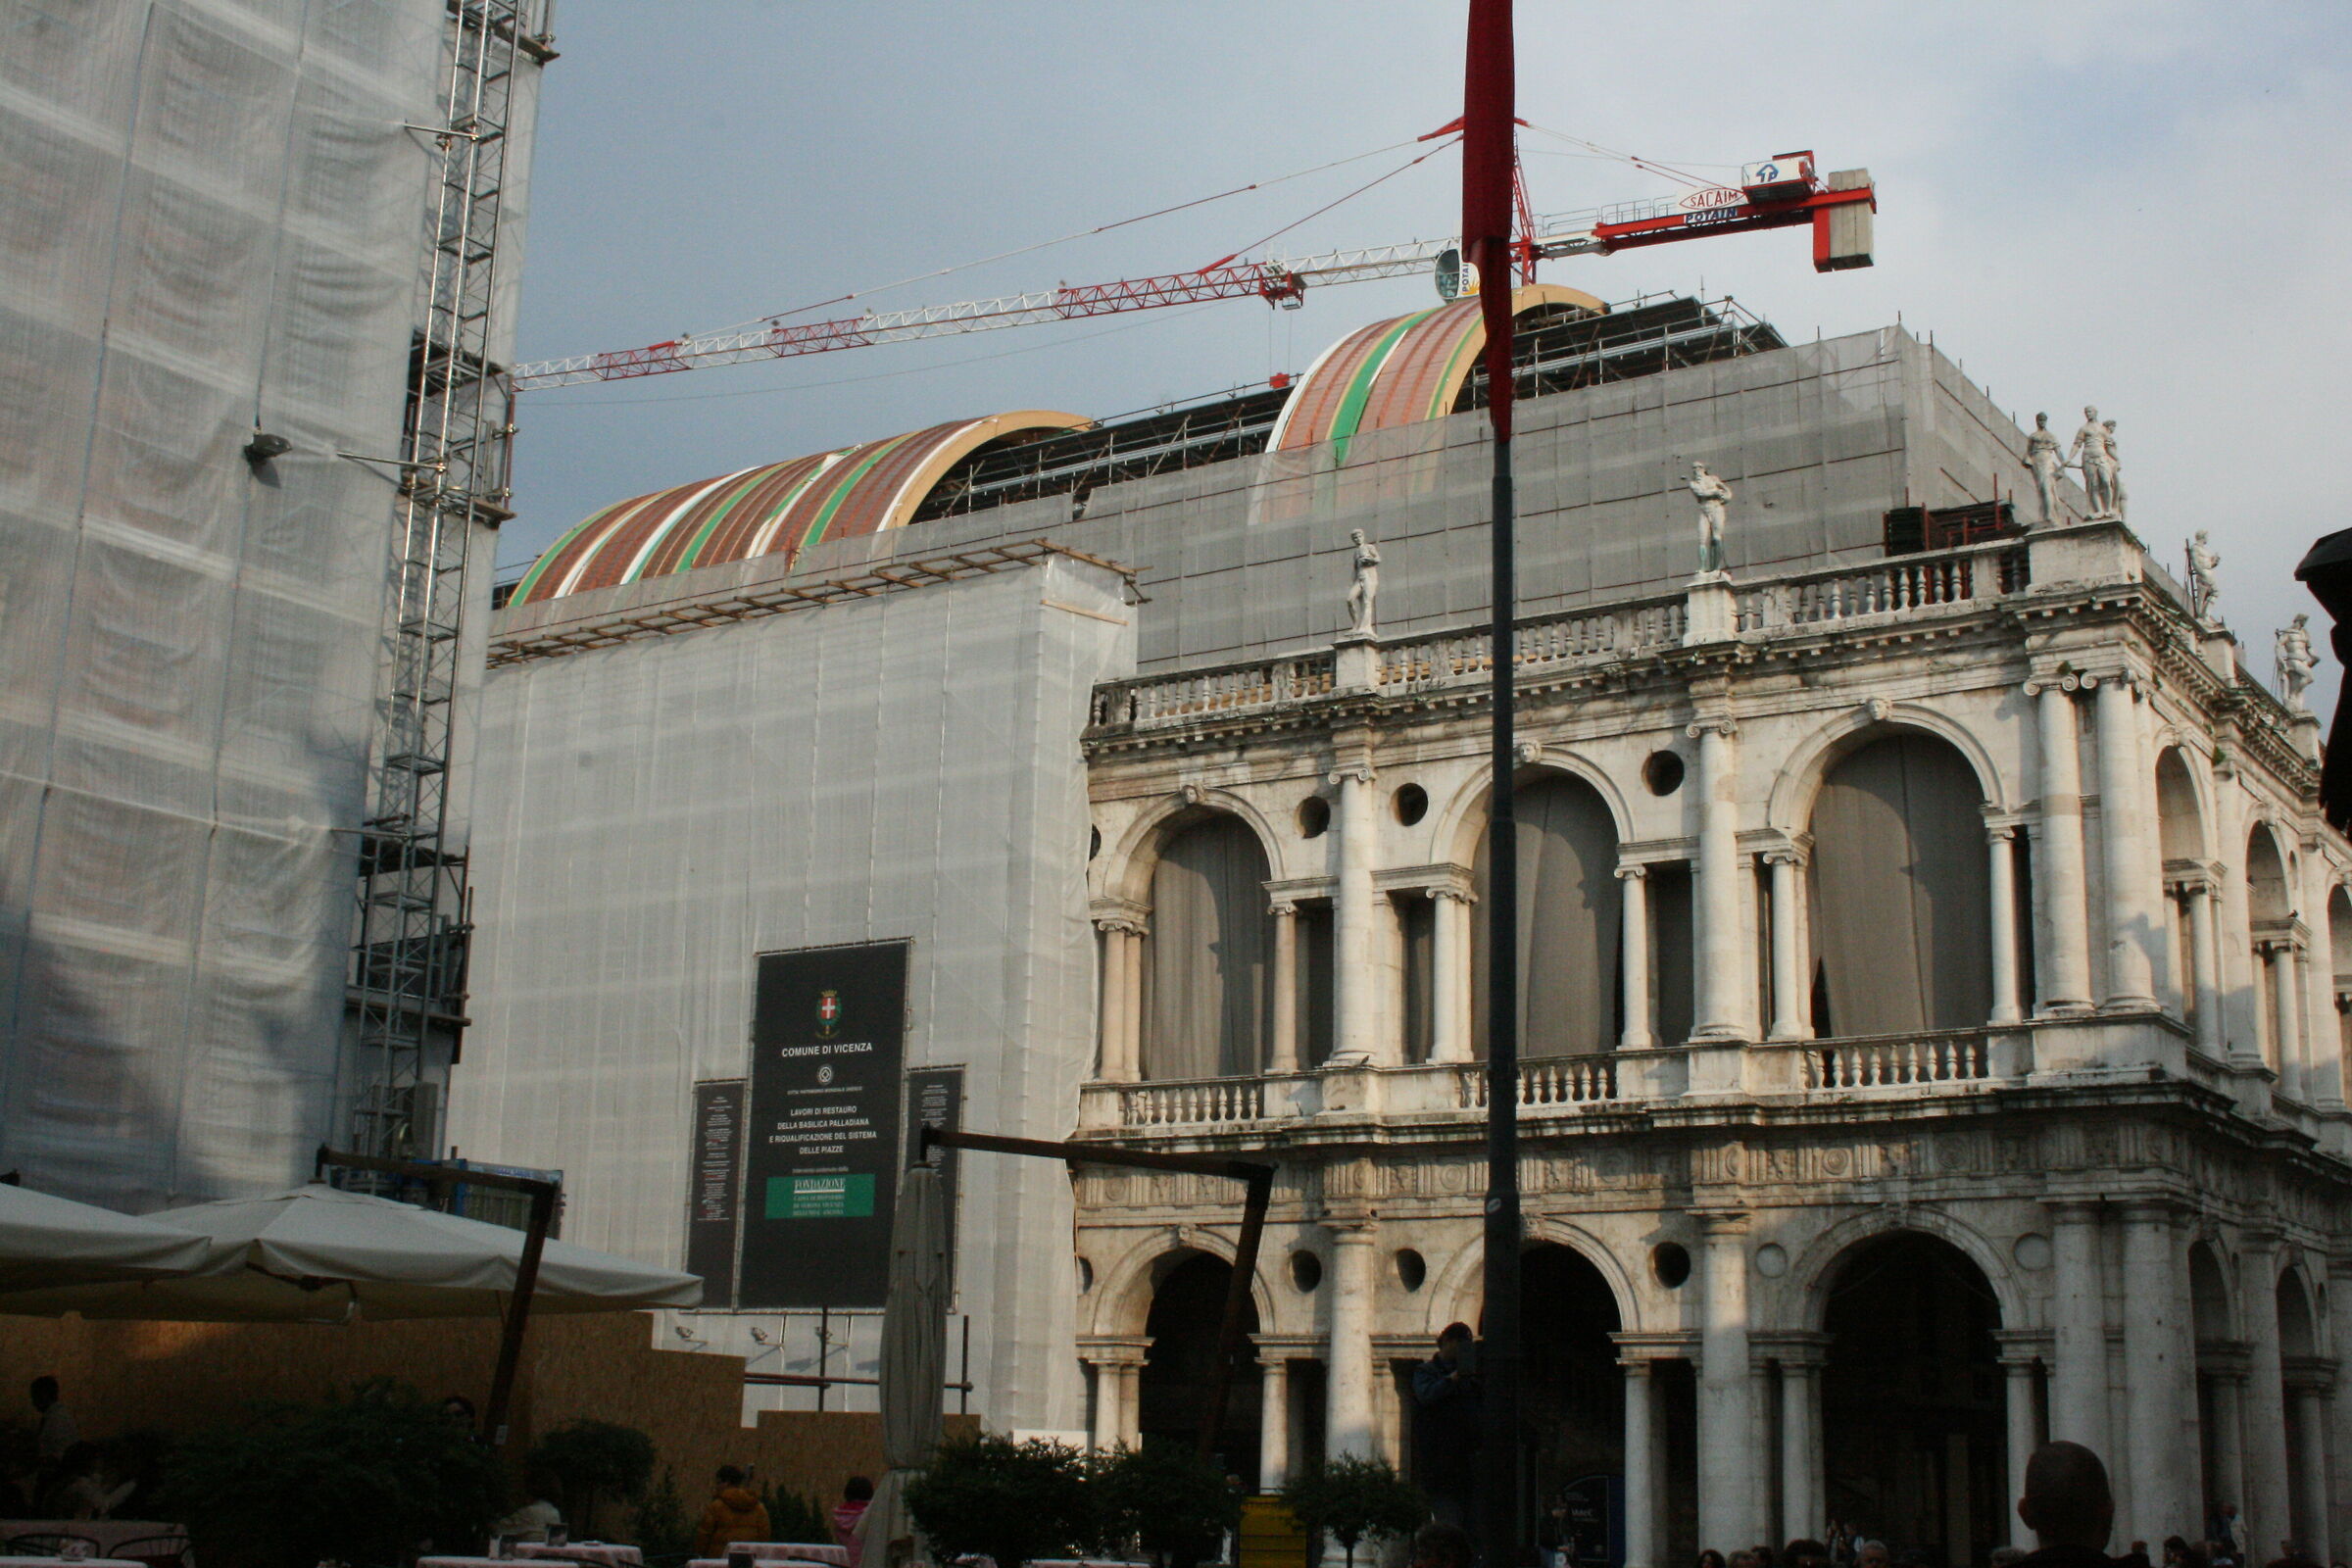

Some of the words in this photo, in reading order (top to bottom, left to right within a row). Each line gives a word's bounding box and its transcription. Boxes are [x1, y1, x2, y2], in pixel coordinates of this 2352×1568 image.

[1690, 190, 1738, 207] SACAIM
[1686, 208, 1738, 223] POTAIN
[782, 1046, 819, 1056] COMUNE
[821, 1045, 832, 1054] DI
[834, 1043, 872, 1053] VICENZA
[790, 1107, 813, 1117] LAVORI
[822, 1105, 858, 1115] RESTAURO
[777, 1121, 798, 1130] DELLA
[799, 1120, 828, 1129] BASILICA
[774, 1133, 833, 1143] RIQUALIFICAZIONE
[834, 1132, 847, 1141] DEL
[848, 1131, 877, 1140] SISTEMA
[821, 1145, 844, 1153] PIAZZE
[794, 1177, 846, 1191] FONDAZIONE
